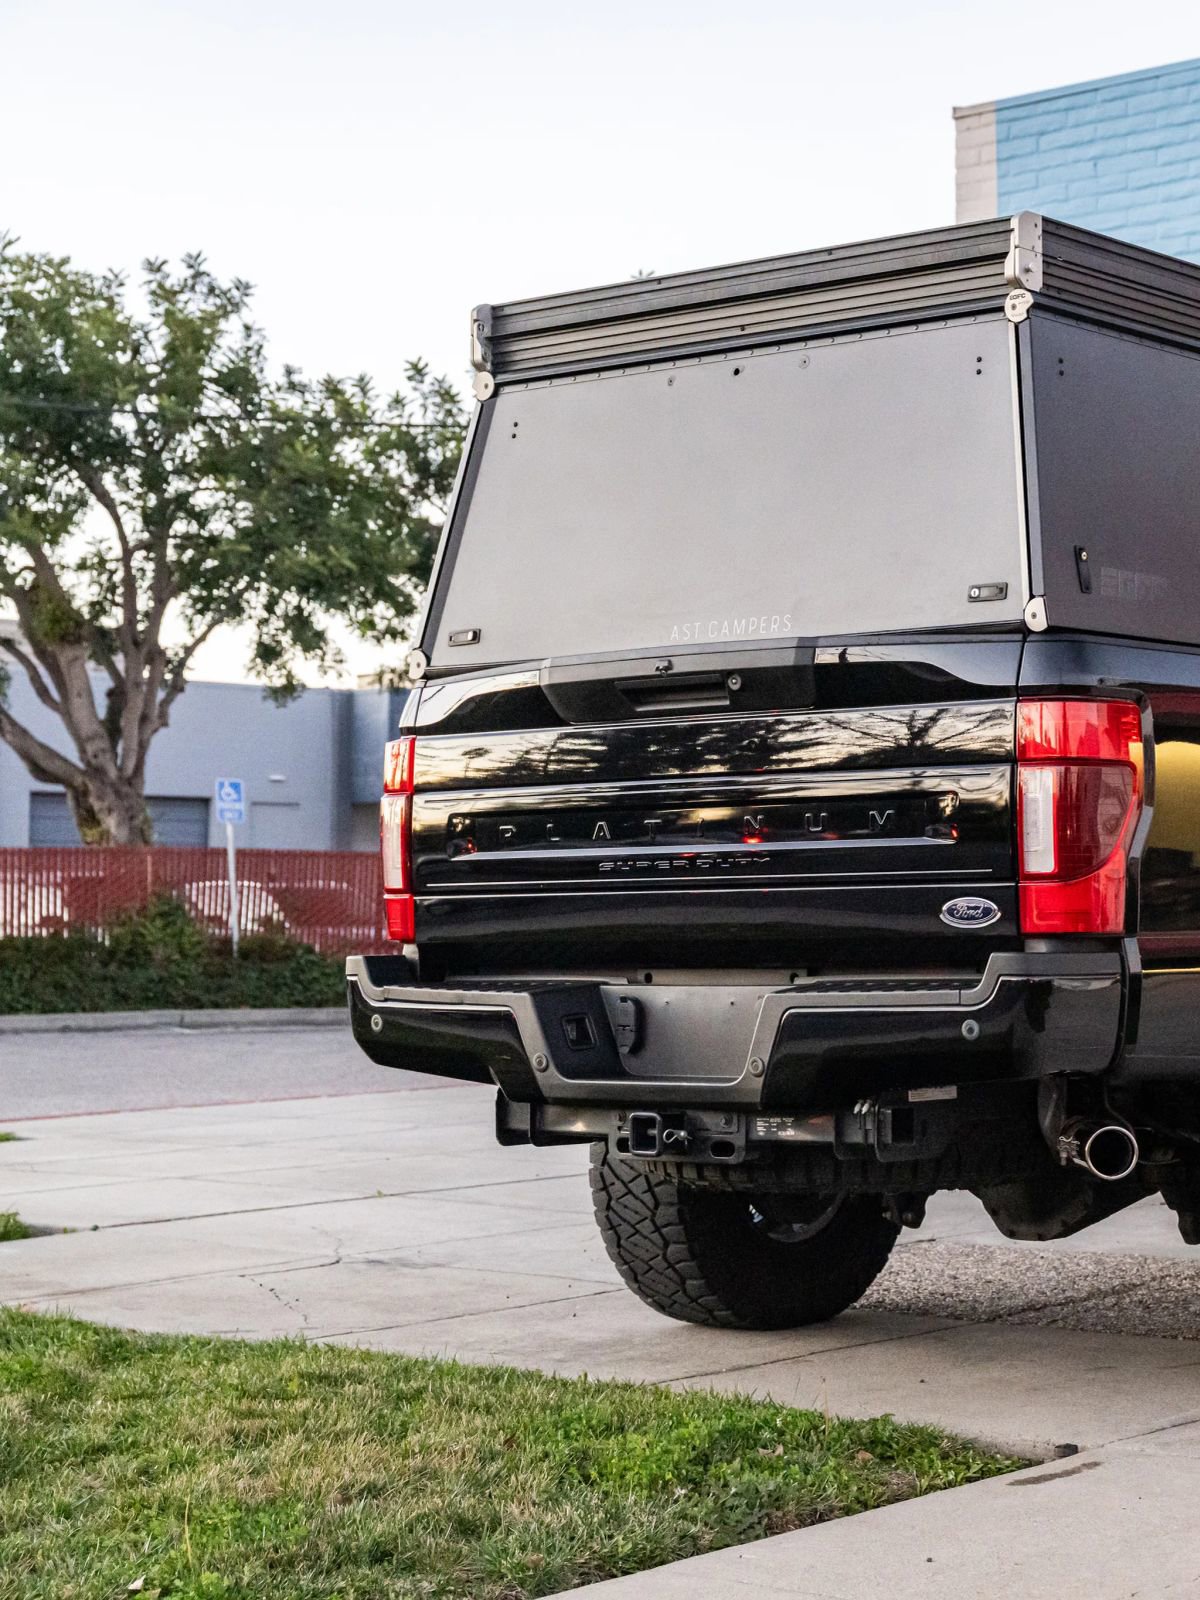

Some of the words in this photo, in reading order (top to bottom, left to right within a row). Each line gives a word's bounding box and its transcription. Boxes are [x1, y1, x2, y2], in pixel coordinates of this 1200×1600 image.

[670, 622, 701, 641] AST
[708, 614, 792, 638] CAMPERS
[499, 809, 895, 842] PLATINUM
[599, 859, 690, 872] SUPER
[696, 856, 771, 869] DUTY
[952, 902, 984, 918] Ford
